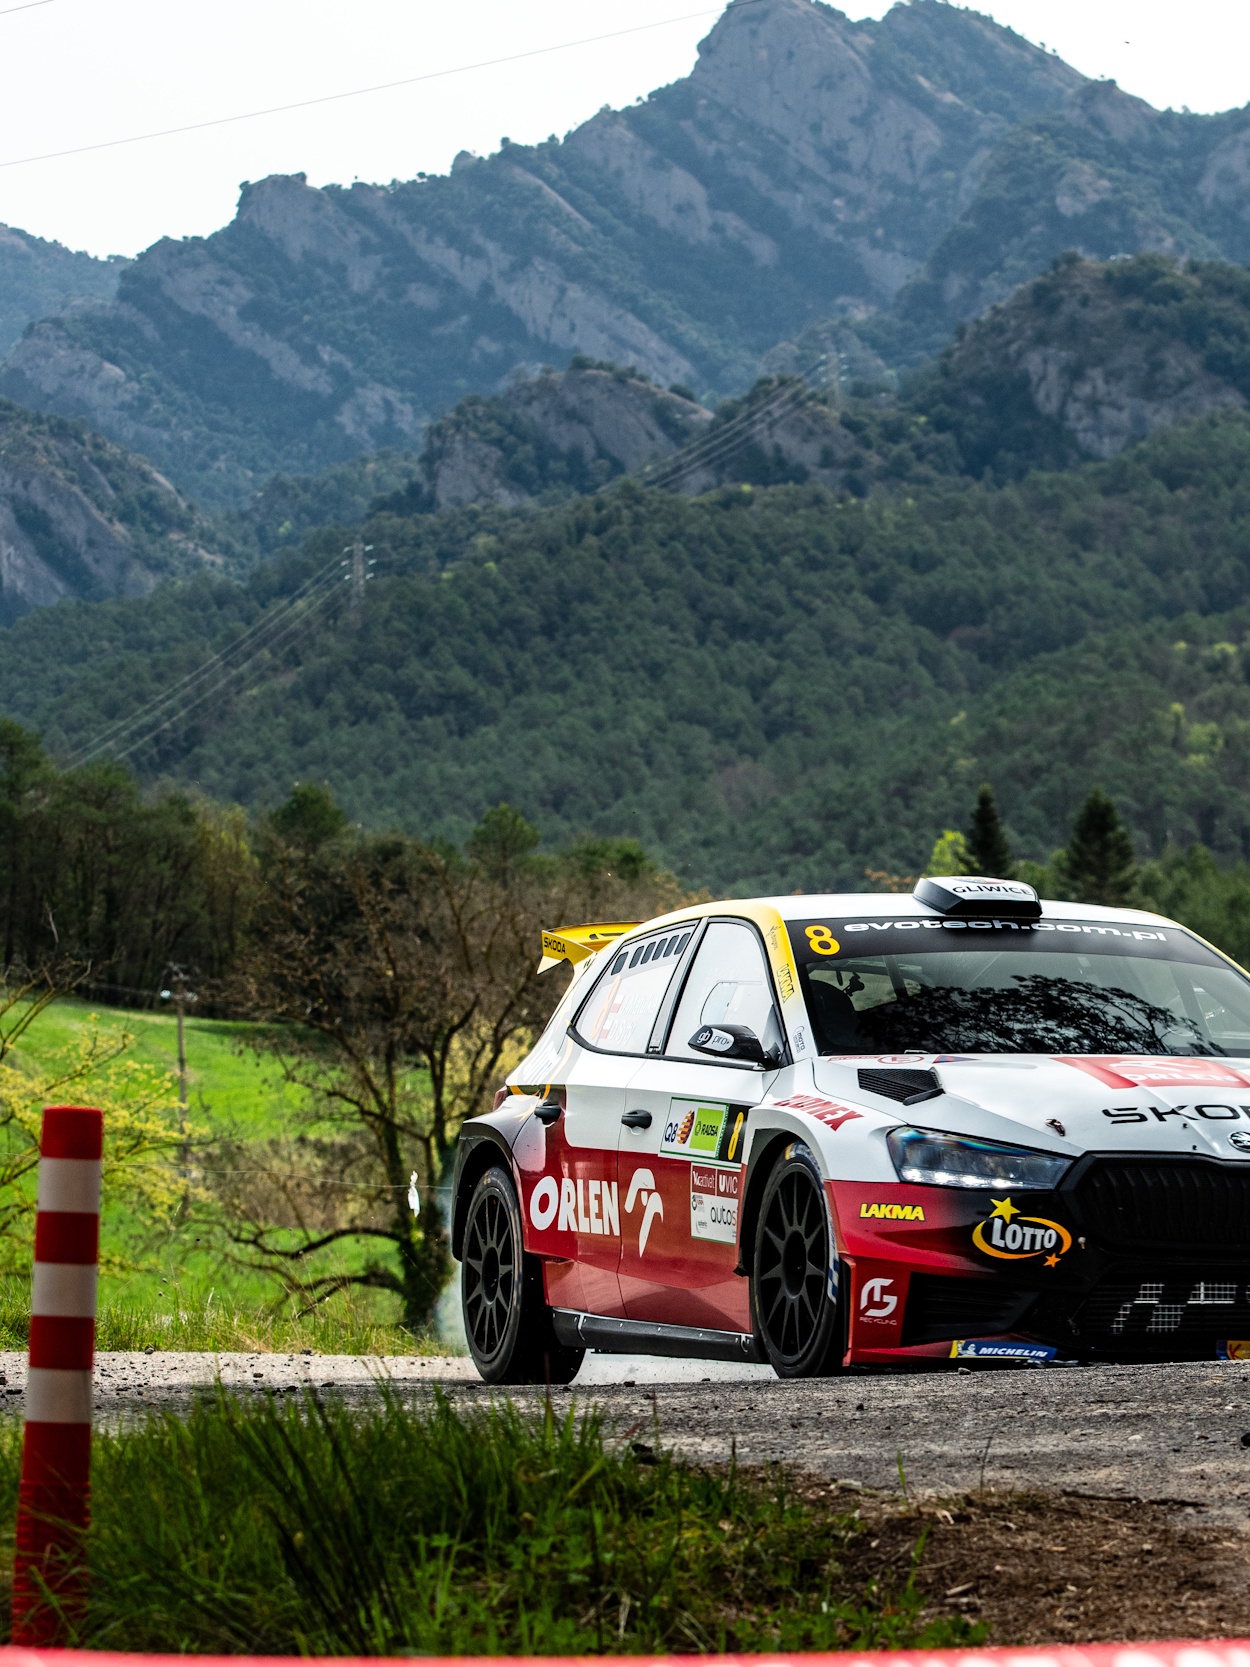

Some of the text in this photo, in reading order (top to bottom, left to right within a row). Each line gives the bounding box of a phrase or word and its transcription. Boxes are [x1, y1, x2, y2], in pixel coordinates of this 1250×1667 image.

[952, 884, 1033, 896] GLIWICE
[804, 924, 841, 956] 8
[843, 919, 1168, 942] evotech.com.pl
[1121, 1073, 1242, 1083] ORLEN
[664, 1122, 679, 1143] Q8
[700, 1124, 719, 1137] RADSA
[727, 1111, 745, 1161] 8
[719, 1174, 738, 1195] UVIC
[530, 1175, 620, 1236] ORLEN
[859, 1203, 926, 1221] LAKMA
[991, 1217, 1058, 1250] LOTTO
[979, 1347, 1049, 1358] MICHELIN
